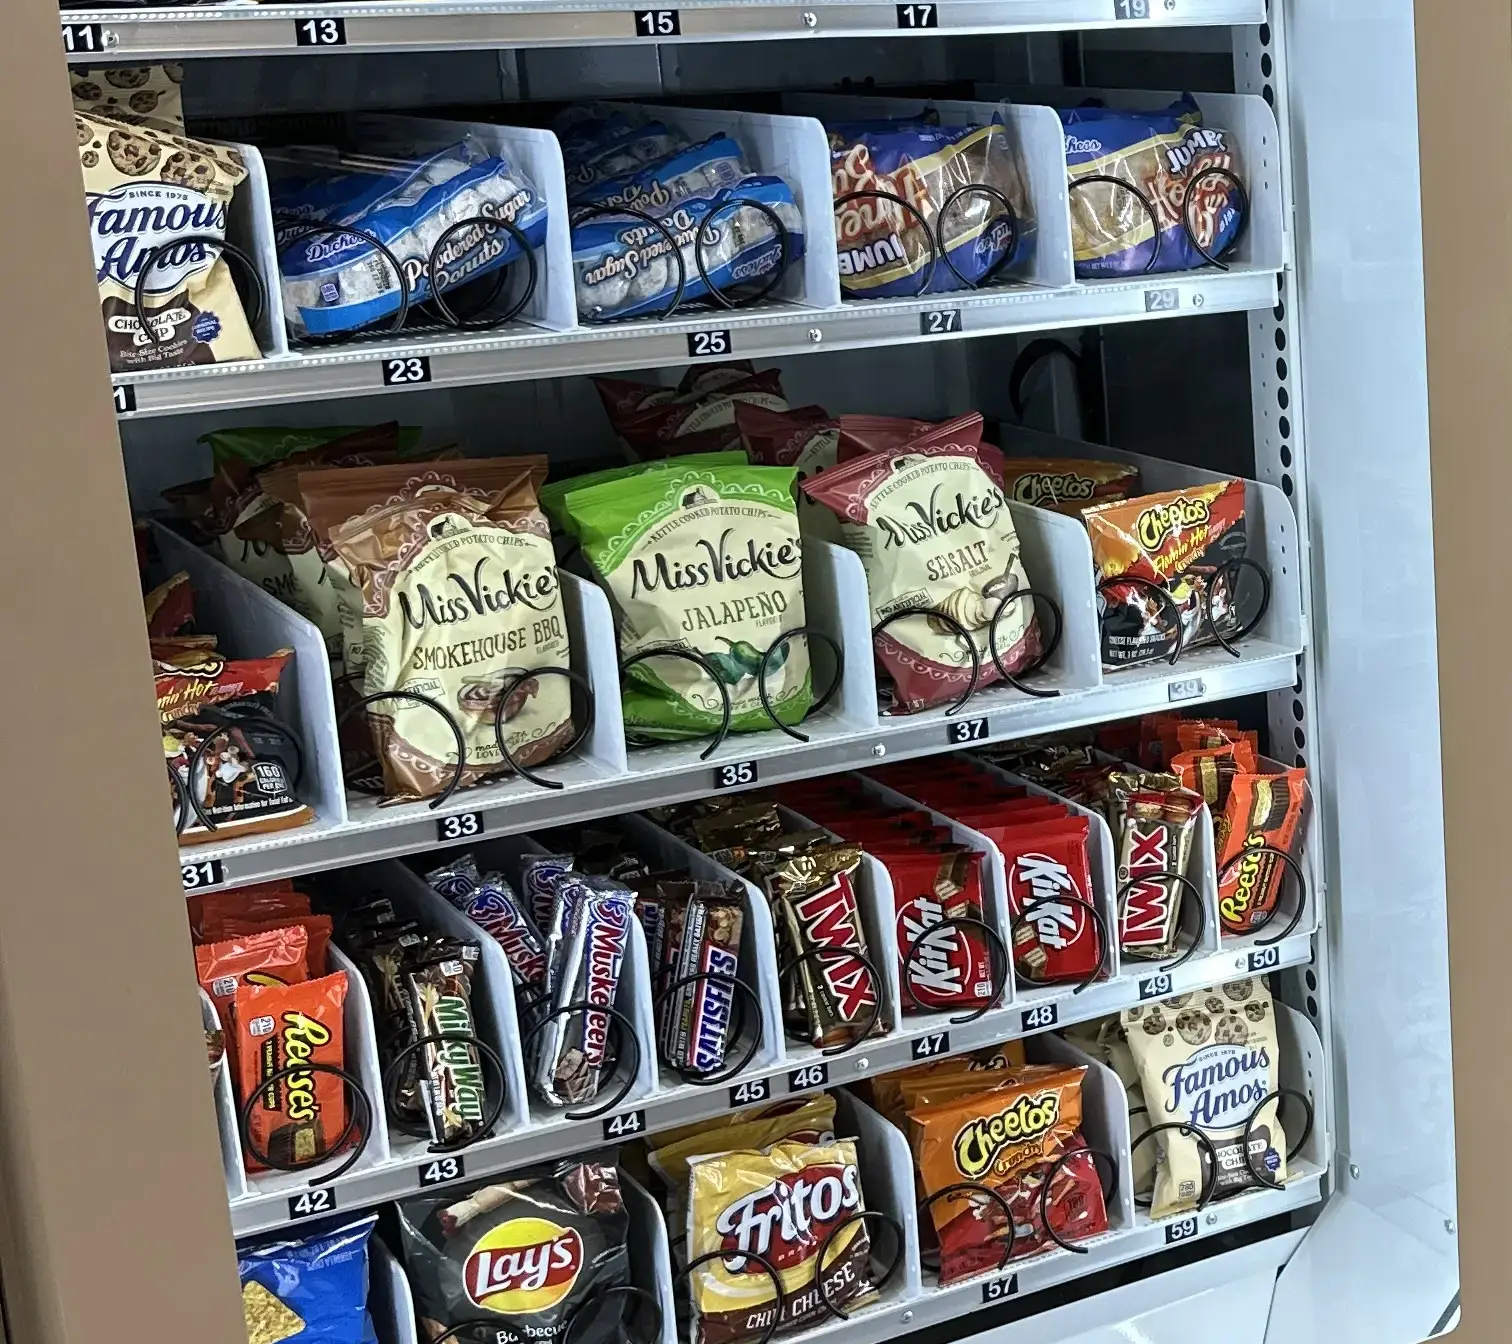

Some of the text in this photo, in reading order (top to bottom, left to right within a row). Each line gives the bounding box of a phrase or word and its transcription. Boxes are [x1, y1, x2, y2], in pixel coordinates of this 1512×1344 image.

[641, 11, 675, 35] 15
[903, 5, 933, 28] 17
[302, 19, 340, 45] 13
[1150, 292, 1175, 312] 29
[928, 311, 956, 332] 27
[694, 331, 727, 354] 25
[388, 358, 425, 383] 23
[1014, 472, 1096, 506] Cheetos
[741, 507, 769, 519] CHIPS
[905, 482, 1005, 535] Vickie's
[1137, 497, 1210, 551] Cheetos
[1188, 522, 1213, 549] Hot
[631, 527, 802, 600] Miss Vickie's
[447, 556, 560, 616] Vickie's
[682, 589, 788, 632] JALAPEÑO
[411, 614, 565, 671] SMOKEHOUSE BBQ
[183, 679, 213, 698] Hot
[956, 720, 984, 743] 37
[257, 764, 280, 778] 160
[721, 764, 753, 788] 35
[443, 815, 480, 839] 33
[181, 863, 214, 888] 31
[1118, 824, 1169, 948] TWIX
[1220, 833, 1266, 923] Reese's
[797, 870, 878, 1021] TWIX
[1253, 948, 1279, 967] 50
[583, 924, 625, 1068] Muskeeers
[1143, 976, 1170, 995] 49
[1026, 1006, 1054, 1027] 48
[916, 1033, 944, 1055] 47
[281, 1010, 331, 1122] Reese's
[793, 1065, 824, 1087] 46
[1161, 1046, 1271, 1114] Famous
[449, 1063, 484, 1122] Way
[734, 1083, 765, 1103] 45
[1189, 1078, 1265, 1128] Amos
[608, 1112, 641, 1136] 44
[954, 1093, 1061, 1178] Cheetos
[424, 1158, 459, 1182] 43
[293, 1190, 331, 1214] 42
[714, 1165, 860, 1273] Fritos
[1170, 1219, 1196, 1239] 59
[474, 1232, 577, 1302] Lay's
[987, 1277, 1012, 1298] 57
